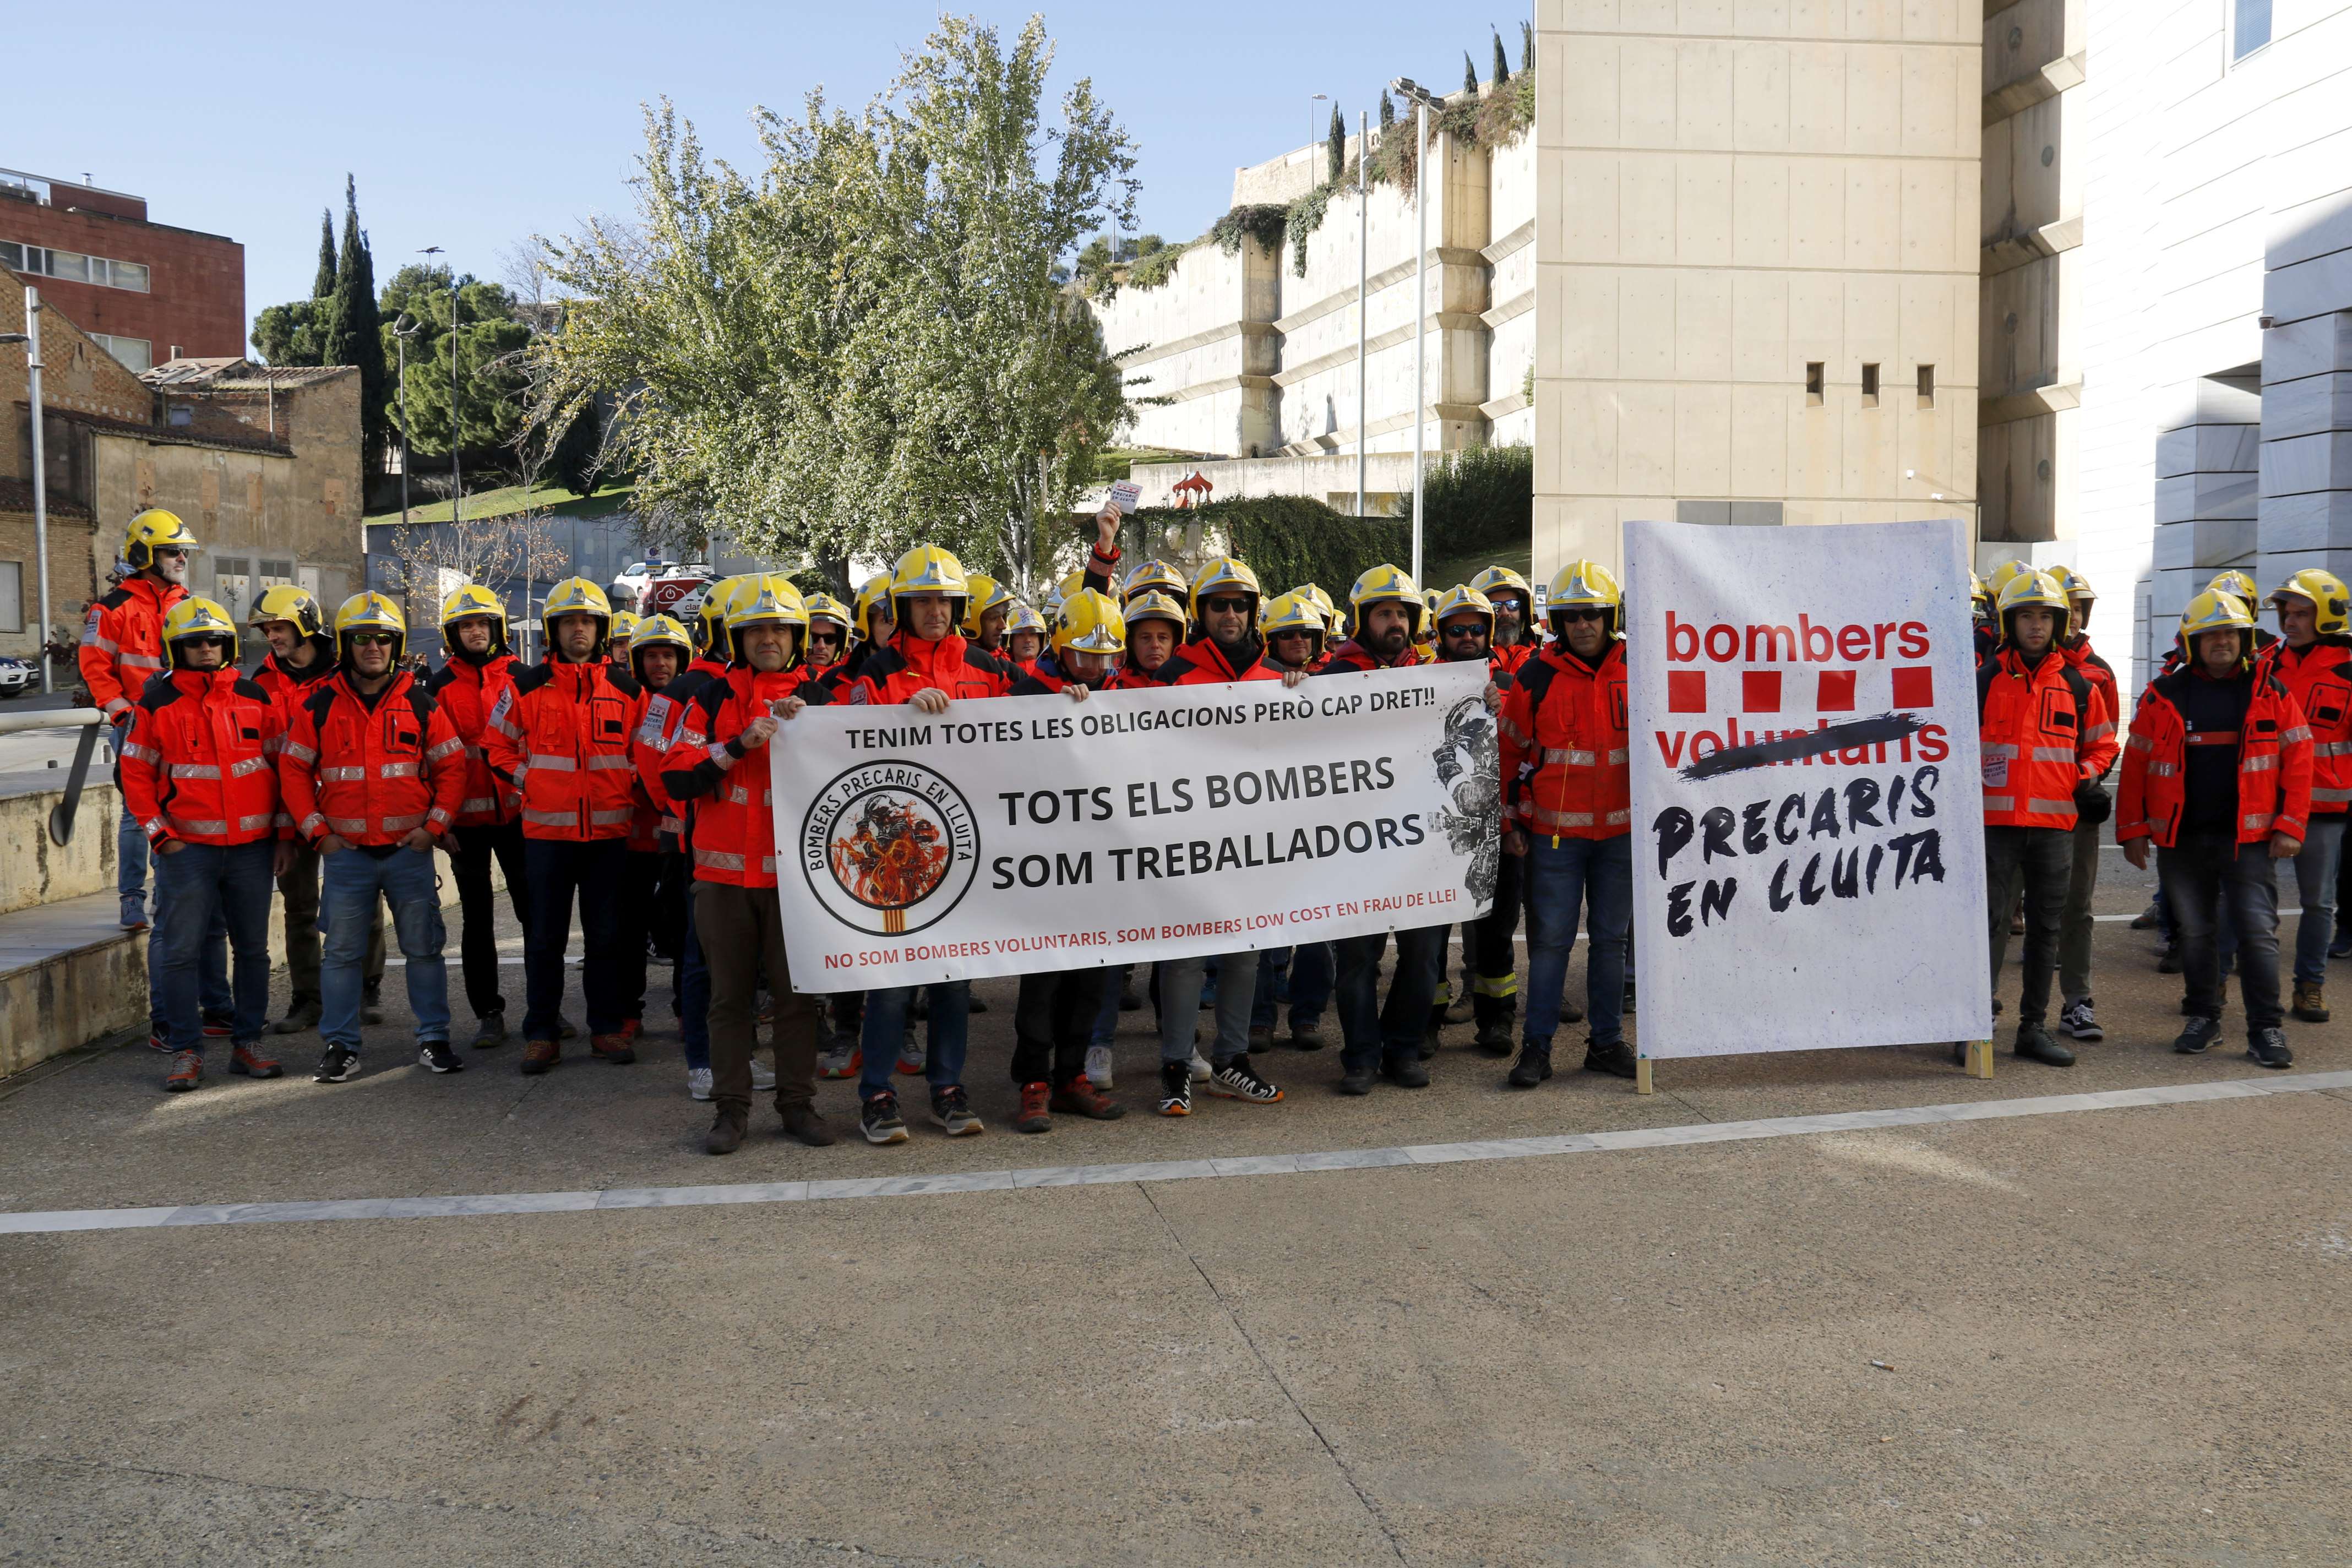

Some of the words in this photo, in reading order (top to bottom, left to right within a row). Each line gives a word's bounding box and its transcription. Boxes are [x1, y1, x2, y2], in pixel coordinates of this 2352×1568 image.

[1666, 611, 1930, 663] bombers
[846, 726, 931, 748] TENIM
[940, 721, 1022, 744] TOTES
[1032, 718, 1073, 739] LES
[1081, 705, 1246, 736] OBLIGACIONS
[1255, 695, 1313, 722] PERÒ
[1322, 695, 1362, 716] CAP
[1370, 687, 1434, 711] DRET!!
[808, 794, 841, 871] BOMBERS
[841, 768, 922, 798] PRECARIS
[926, 782, 949, 803] EN
[945, 804, 972, 860] LLUITA
[999, 787, 1113, 825] TOTS
[1128, 778, 1193, 817] ELS
[1206, 757, 1394, 808] BOMBERS
[1651, 765, 1939, 880] PRECARIS
[993, 852, 1092, 889] SOM
[1108, 814, 1424, 881] TREBALLADORS
[1667, 877, 1737, 937] EN
[1768, 829, 1946, 912] LLUITA
[825, 954, 853, 968] NO
[859, 950, 899, 966] SOM
[905, 941, 989, 961] BOMBERS
[995, 932, 1112, 953] VOLUNTARIS,
[1118, 927, 1155, 943] SOM
[1162, 919, 1242, 938] BOMBERS
[1247, 914, 1283, 929] LOW
[1290, 906, 1330, 923] COST
[1337, 902, 1358, 916] EN
[1364, 897, 1401, 912] FRAU
[1407, 894, 1423, 907] DE
[1429, 890, 1455, 903] LLEI
